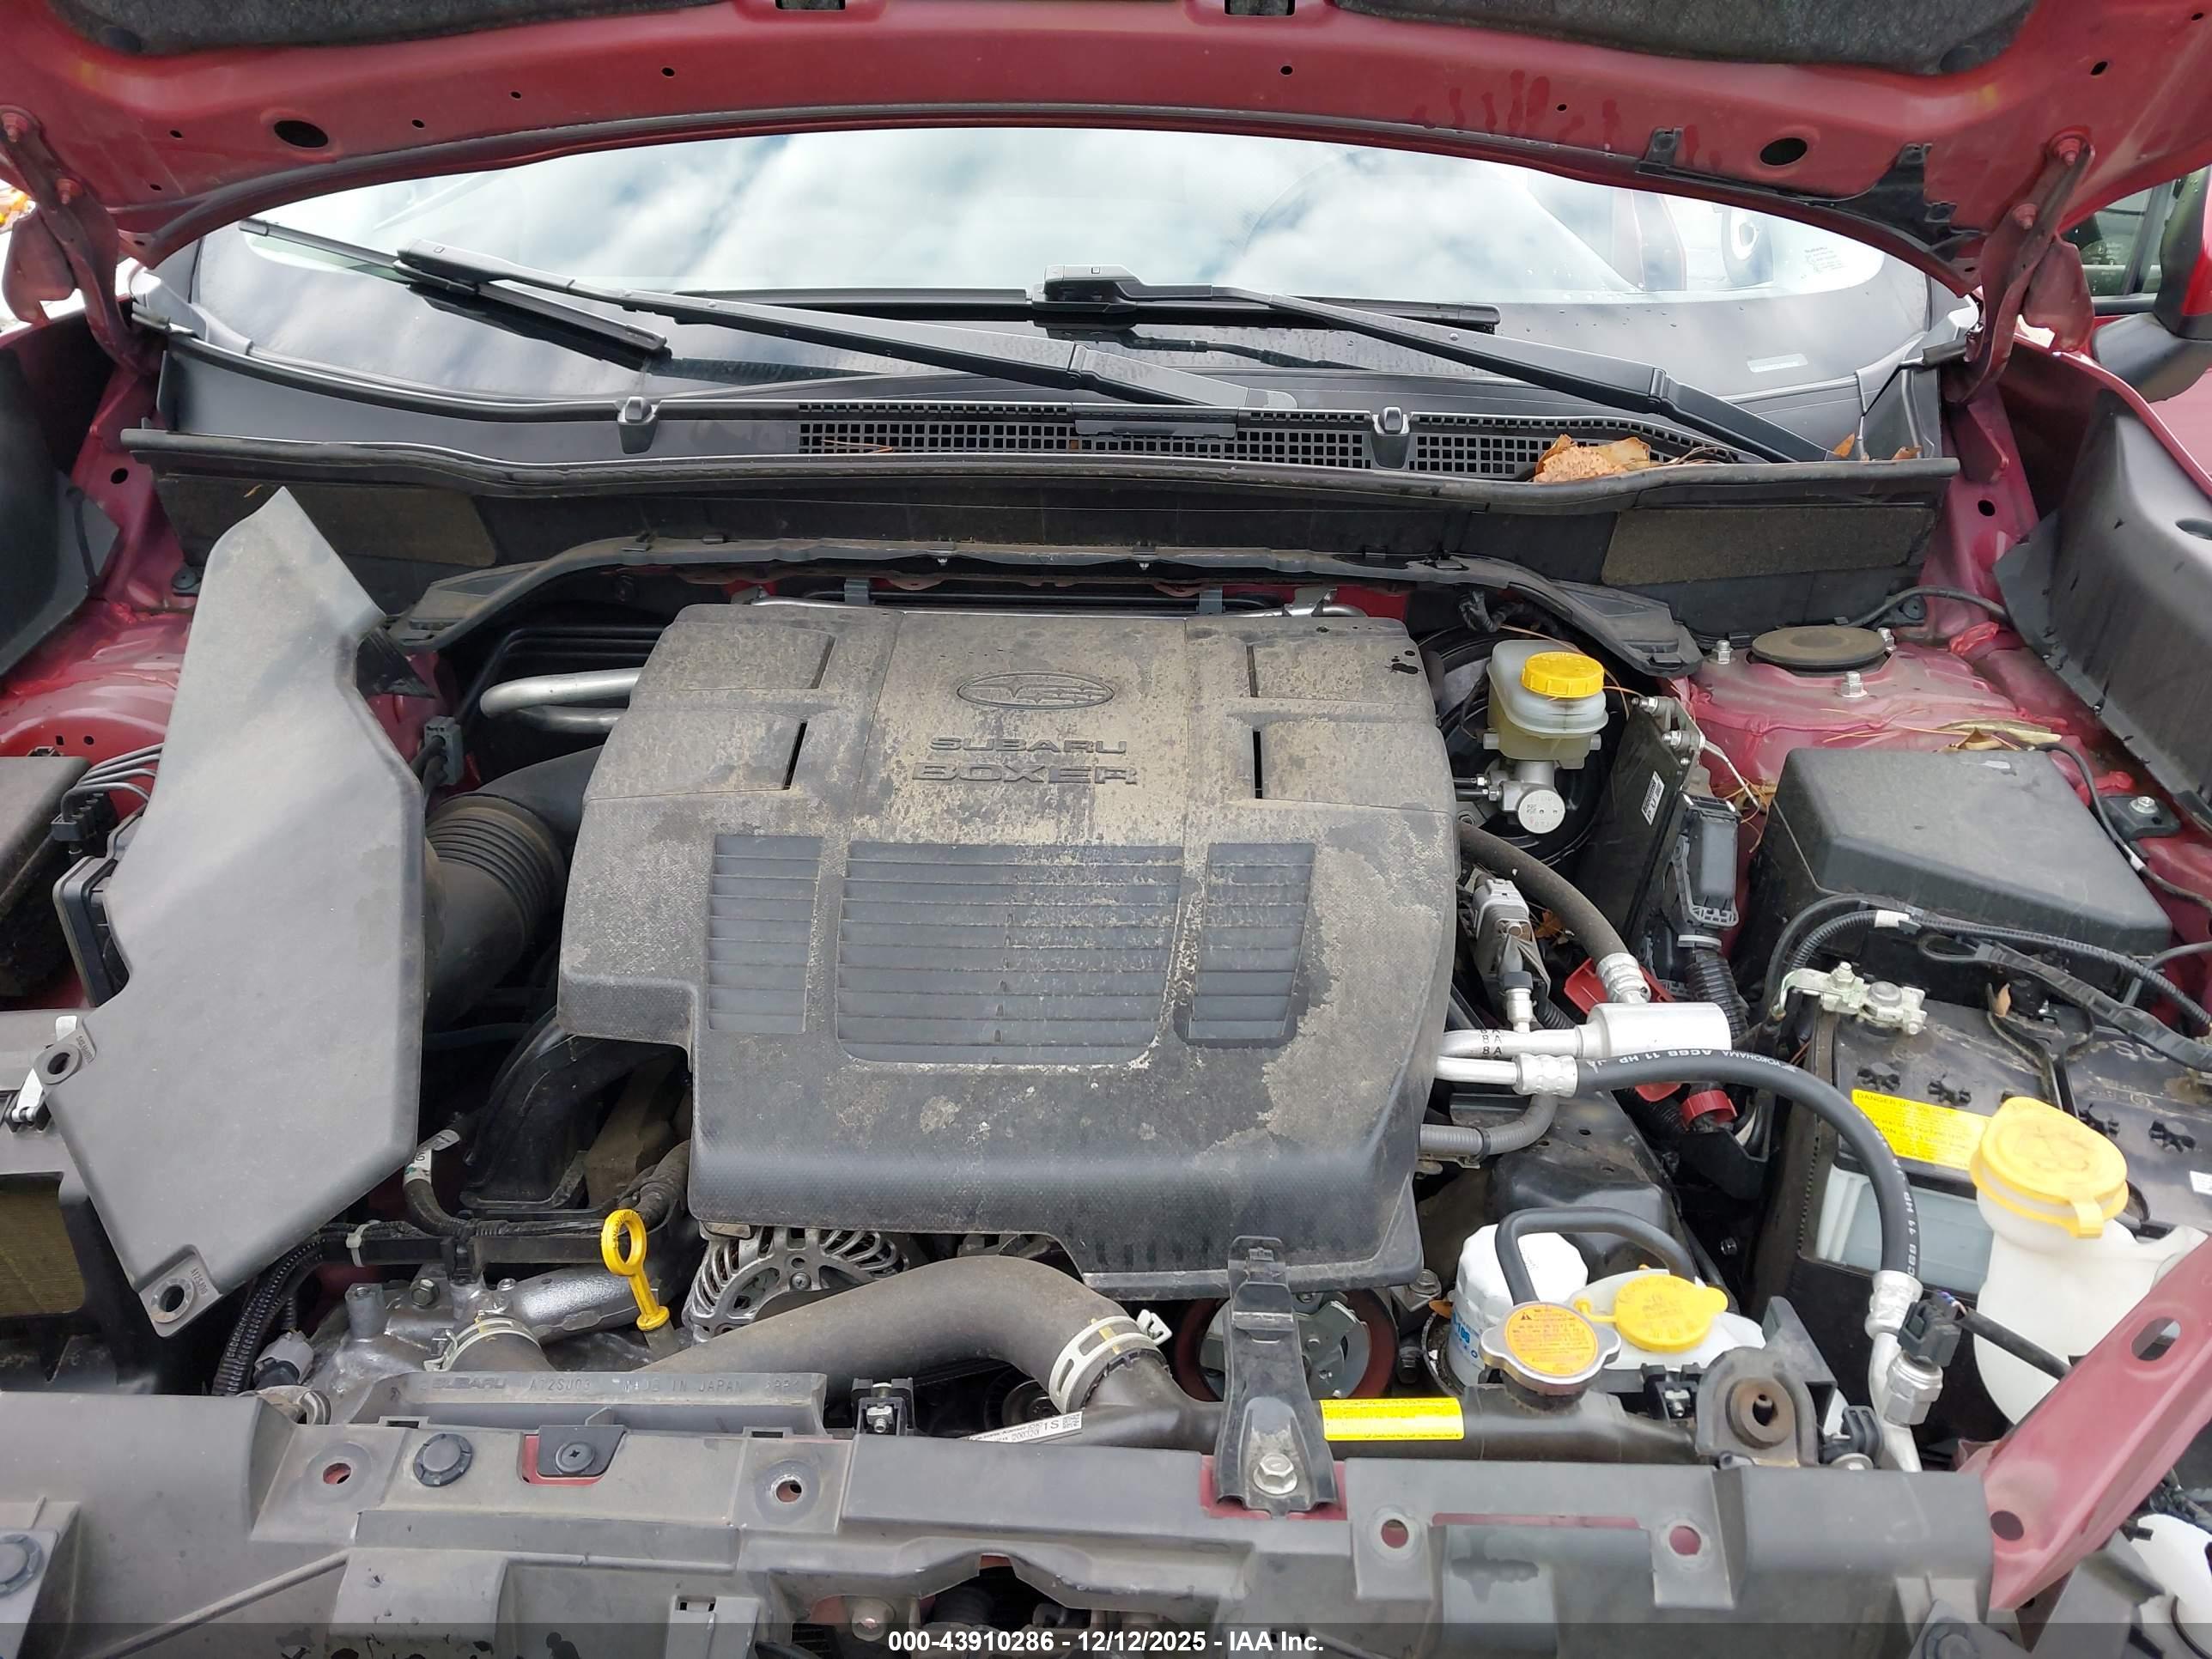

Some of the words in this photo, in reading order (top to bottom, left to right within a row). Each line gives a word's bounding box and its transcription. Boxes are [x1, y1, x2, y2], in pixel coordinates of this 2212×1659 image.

[930, 736, 1127, 755] SUBARU
[912, 761, 1138, 785] BOXER
[697, 1378, 743, 1393] JAPAN
